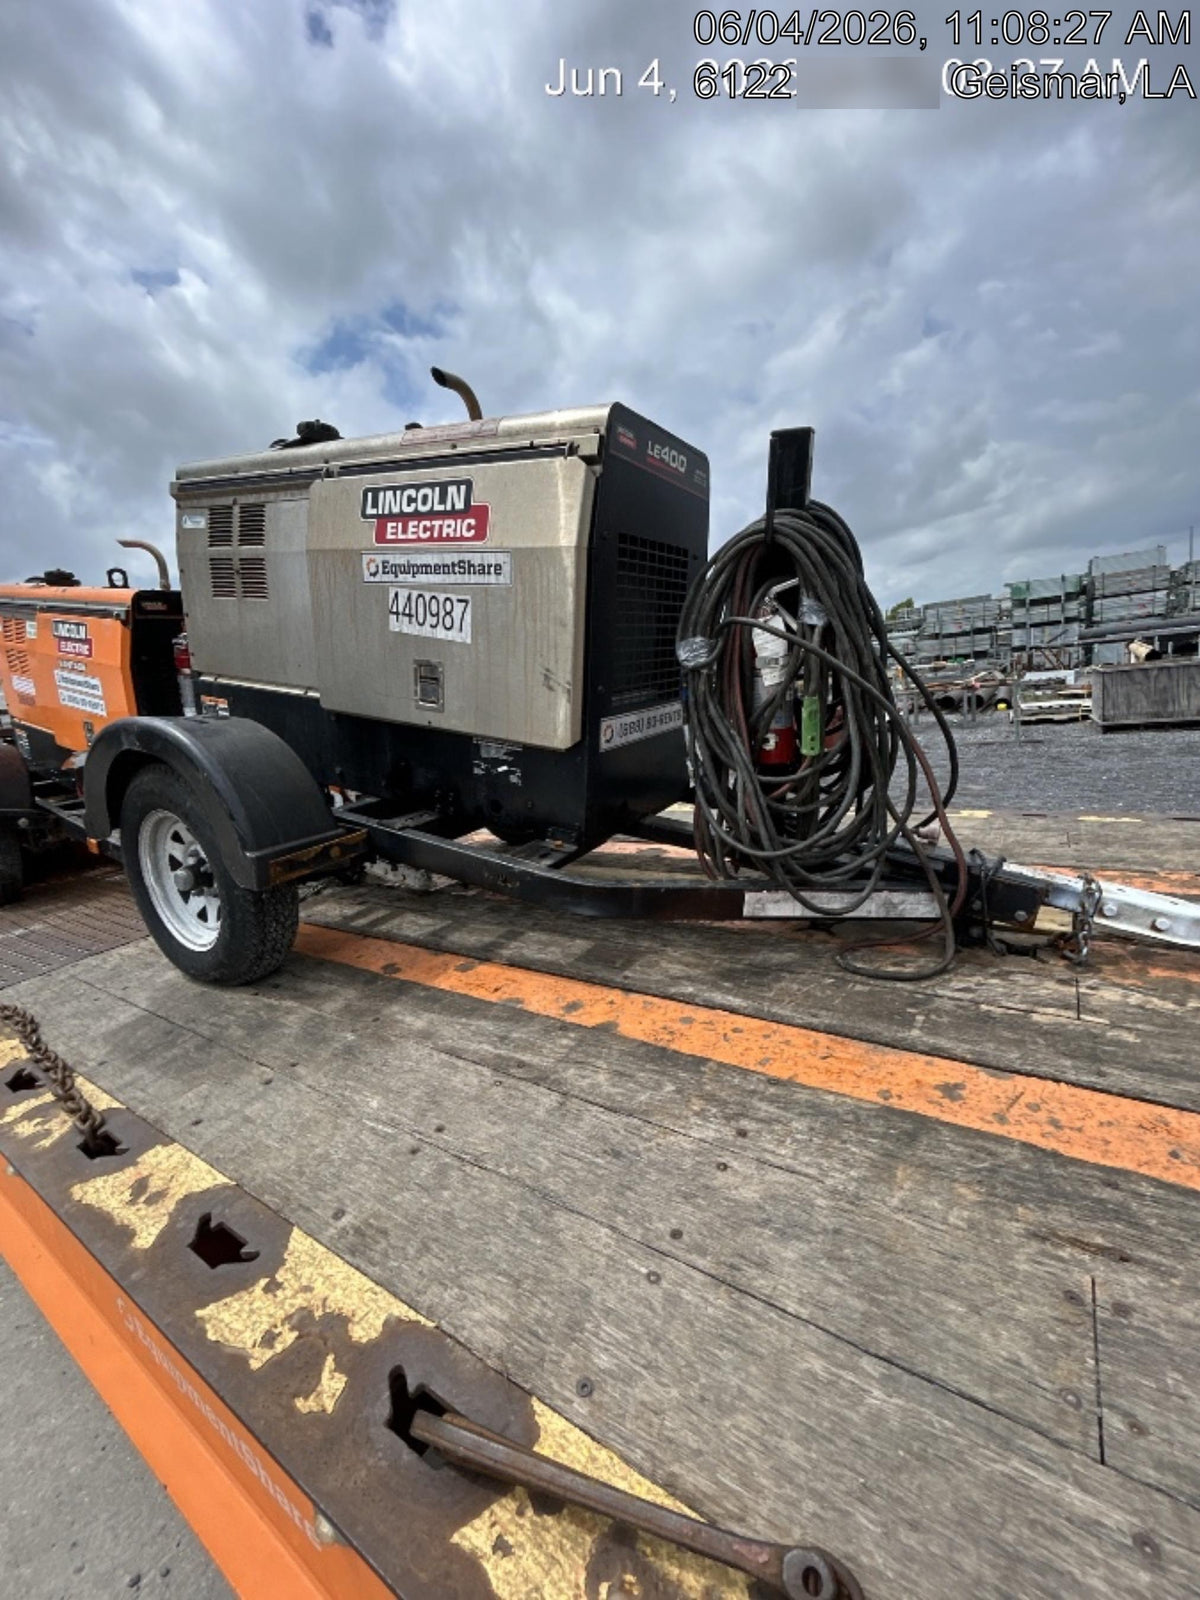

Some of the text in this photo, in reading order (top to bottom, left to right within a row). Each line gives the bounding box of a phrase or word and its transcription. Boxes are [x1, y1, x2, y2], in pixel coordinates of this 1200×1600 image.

[365, 484, 467, 515] LINCOLN
[385, 518, 476, 540] ELECTRIC
[381, 559, 503, 578] EquipmentShare
[389, 591, 470, 633] 440987
